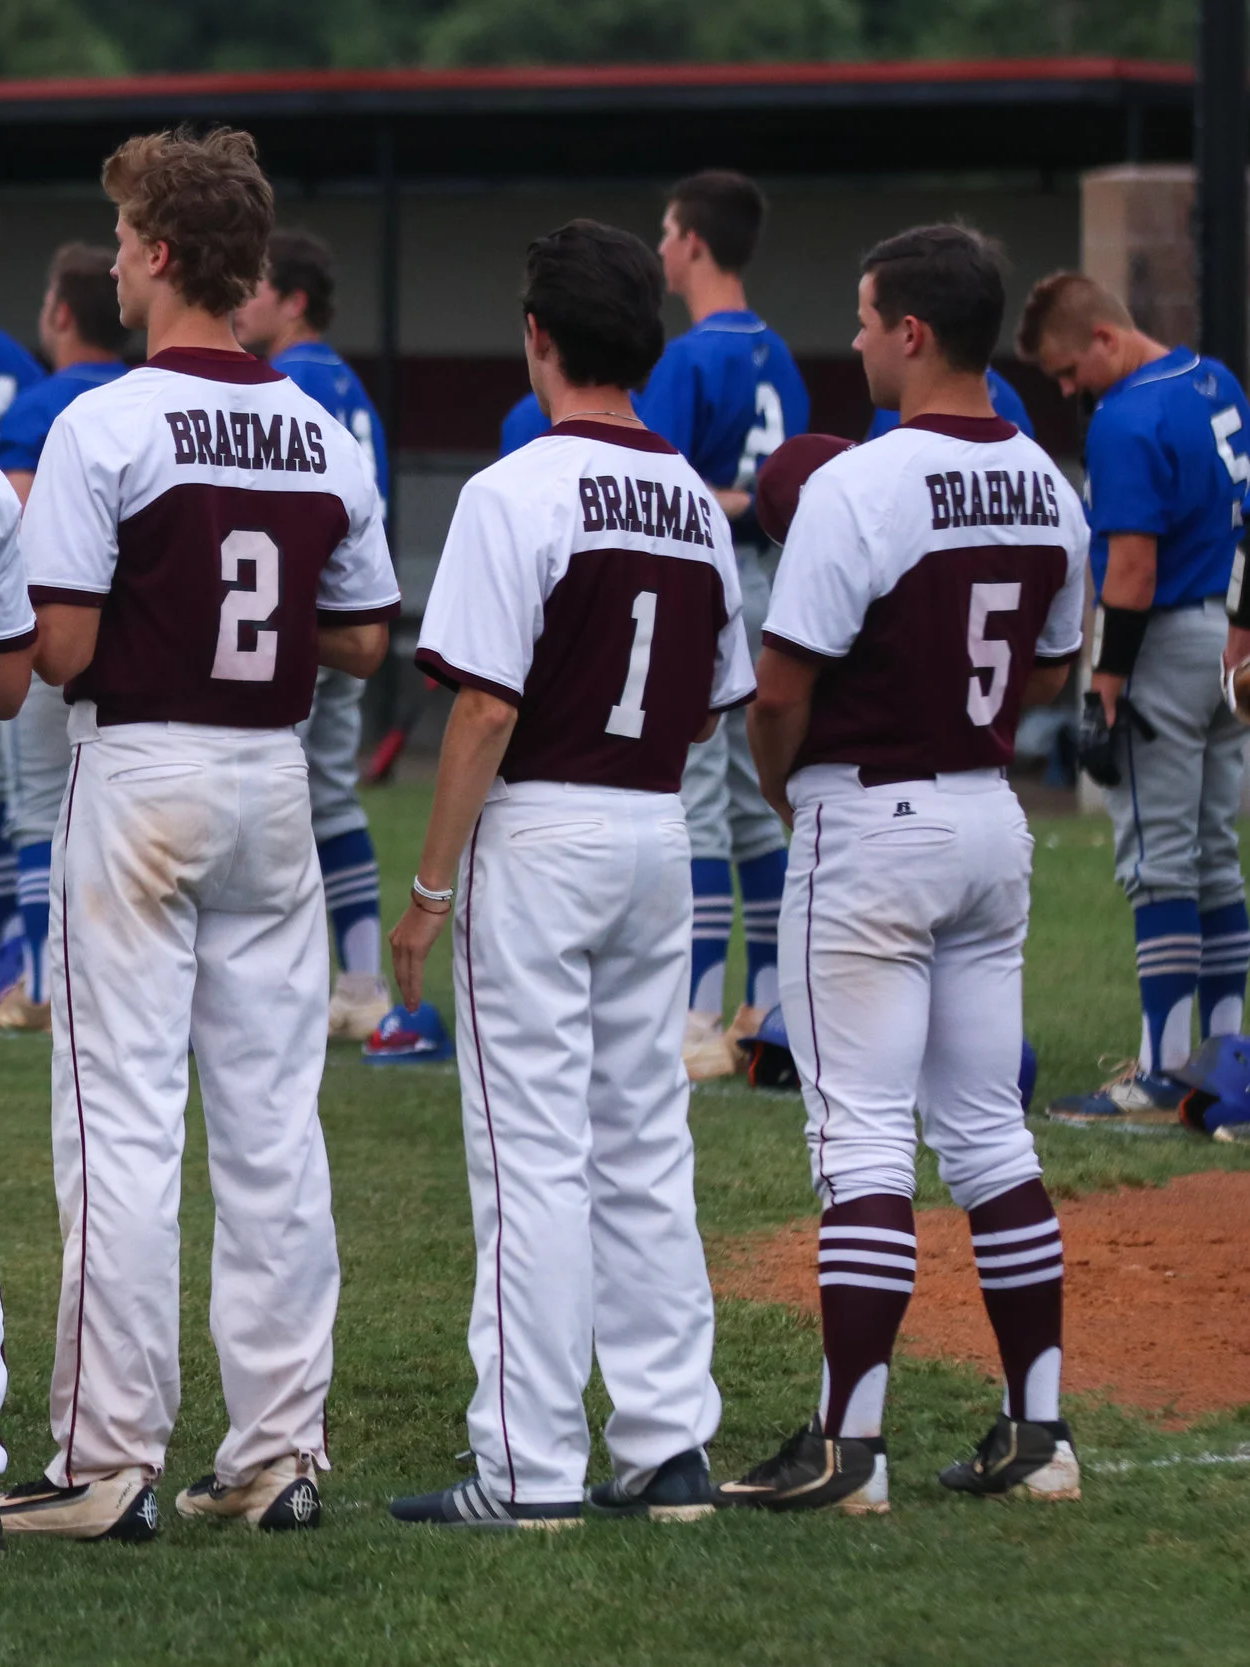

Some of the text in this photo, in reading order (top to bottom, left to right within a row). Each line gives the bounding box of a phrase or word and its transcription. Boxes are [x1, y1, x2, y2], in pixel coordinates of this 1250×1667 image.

[165, 409, 328, 475] BRAHMAS
[578, 475, 715, 551] BRAHMAS
[924, 470, 1061, 531] BRAHMAS
[211, 529, 280, 682] 2
[966, 582, 1022, 726] 5
[604, 590, 658, 739] 1
